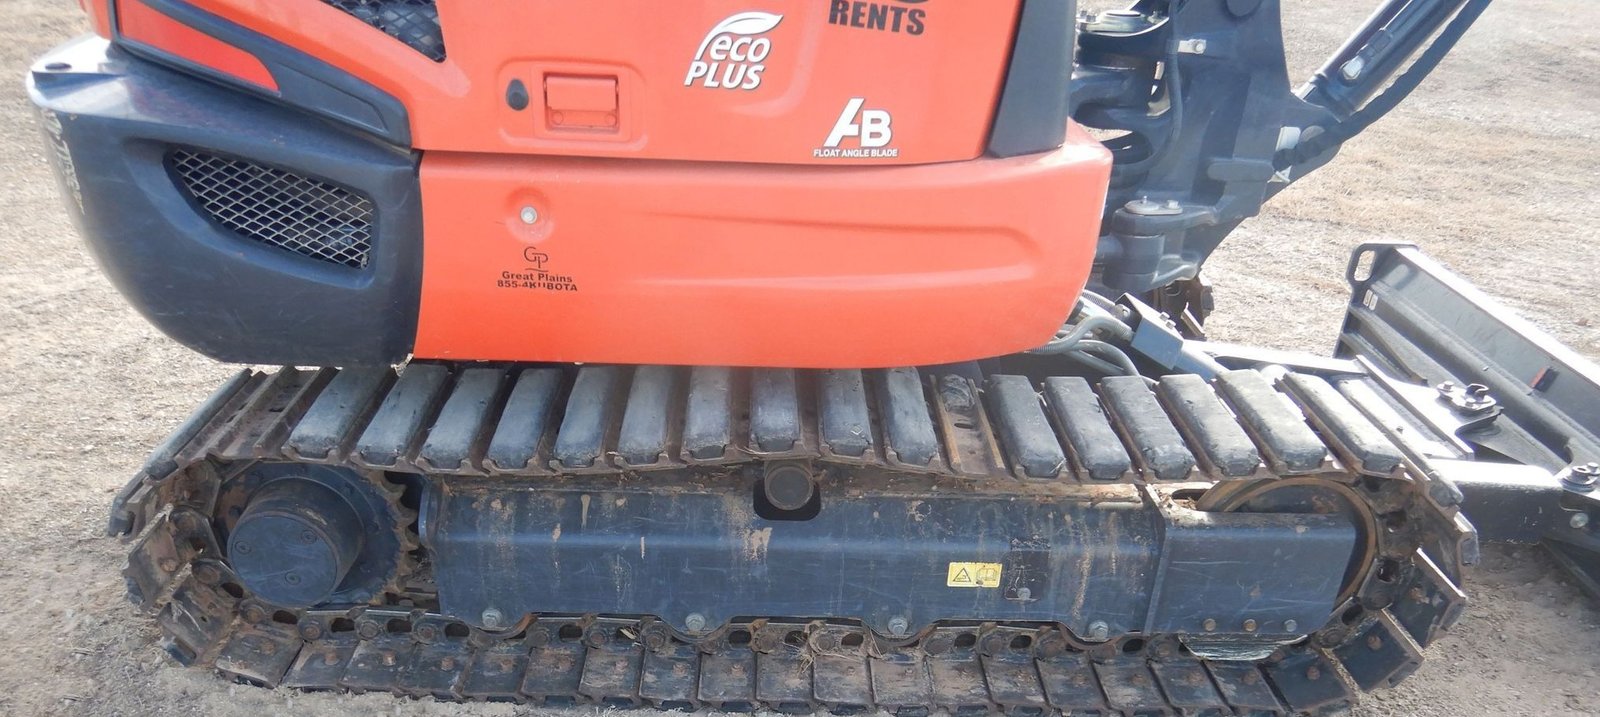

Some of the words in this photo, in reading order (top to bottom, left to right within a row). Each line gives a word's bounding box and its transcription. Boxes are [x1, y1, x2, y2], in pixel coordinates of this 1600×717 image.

[828, 0, 926, 36] RENTS
[709, 37, 771, 62] eco
[684, 62, 764, 90] PLUS
[824, 98, 893, 147] AB
[813, 148, 840, 157] FLOAT
[841, 148, 870, 157] ANGLE
[871, 148, 898, 157] BLADE
[502, 271, 534, 281] Great
[538, 273, 573, 282] Plains
